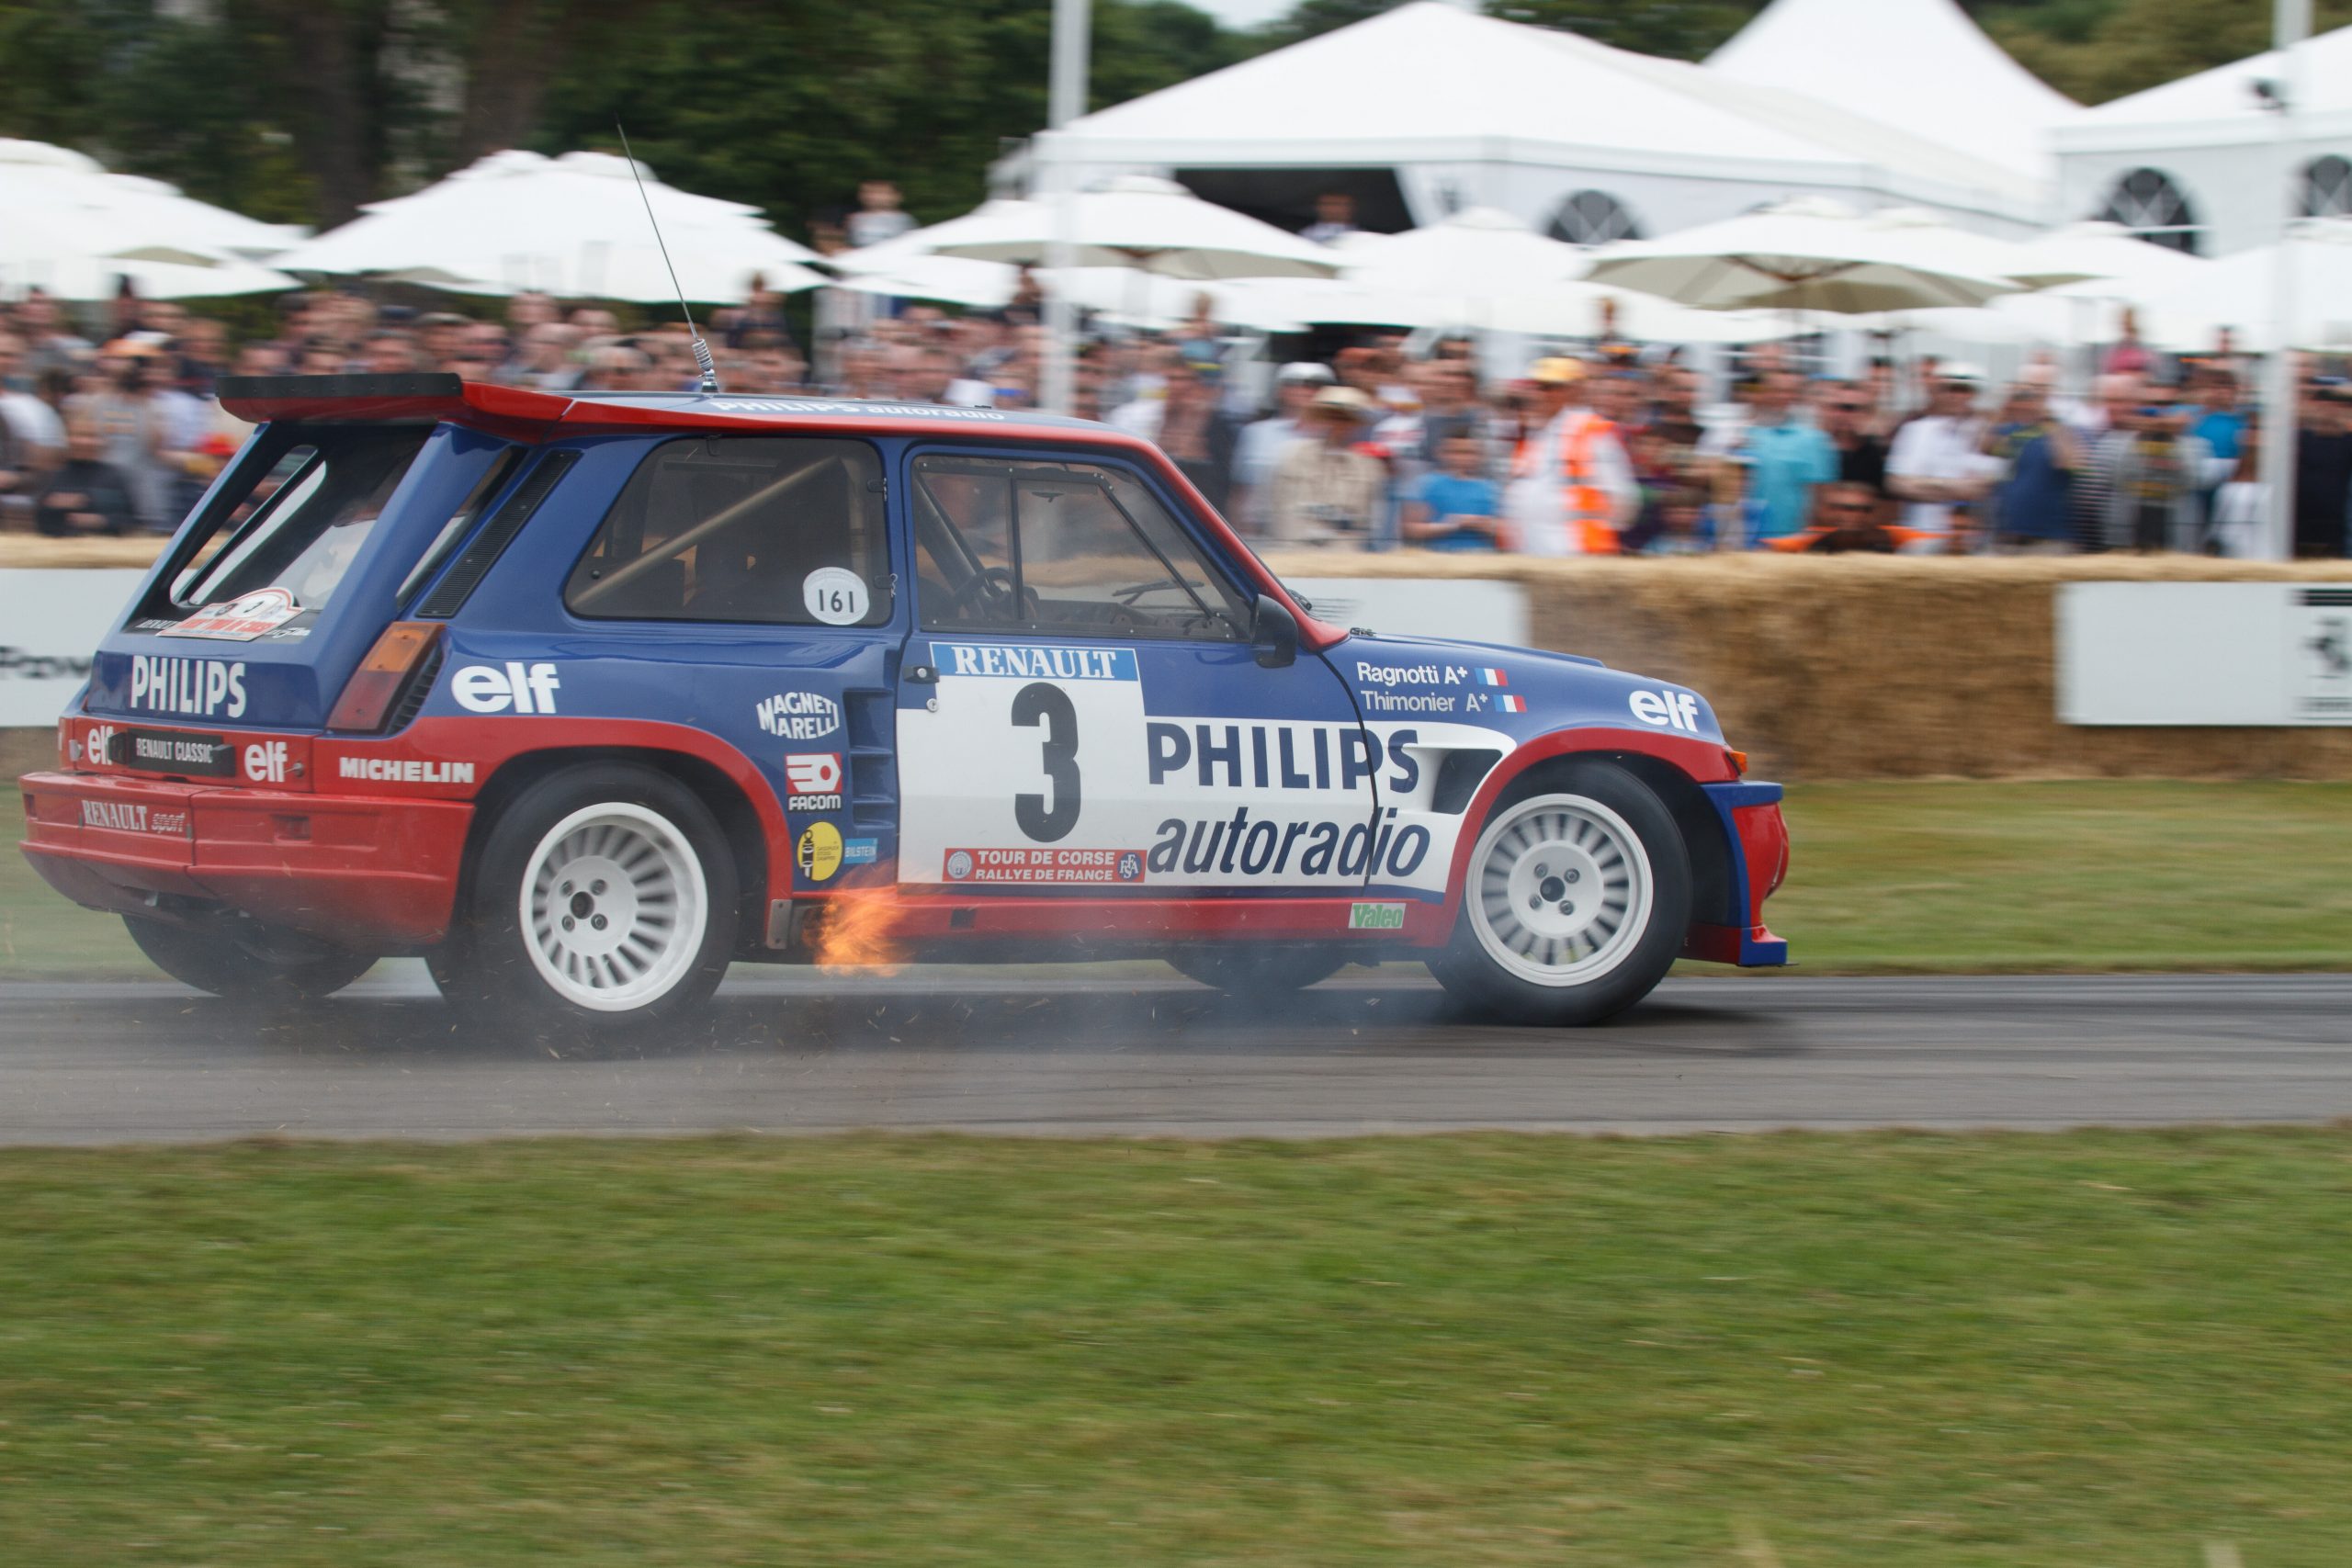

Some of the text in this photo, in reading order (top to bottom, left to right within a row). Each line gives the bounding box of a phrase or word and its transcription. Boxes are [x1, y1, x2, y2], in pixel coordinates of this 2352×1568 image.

[710, 401, 1005, 420] PHILIPS autoradio
[819, 589, 854, 613] 161
[954, 647, 1117, 680] RENAULT
[1357, 661, 1439, 687] Ragnotti
[130, 655, 247, 718] PHILIPS
[451, 661, 560, 714] elf
[1361, 690, 1455, 712] Thimonier
[756, 692, 840, 731] MAGNETI
[1629, 689, 1699, 732] elf
[87, 725, 114, 765] elf
[136, 738, 213, 763] RENAULT CLASSIC
[244, 740, 288, 783] elf
[1146, 722, 1419, 794] PHILIPS
[339, 757, 475, 784] MICHELIN
[1011, 682, 1081, 843] 3
[82, 800, 186, 833] RENAULT sport
[788, 795, 842, 810] FACOM
[978, 851, 1025, 865] TOUR
[1031, 851, 1053, 865] DE
[1057, 852, 1114, 865] CORSE
[1147, 806, 1430, 877] autoradio
[975, 869, 1114, 881] RALLYE DE FRANCE
[1352, 904, 1404, 928] Valeo
